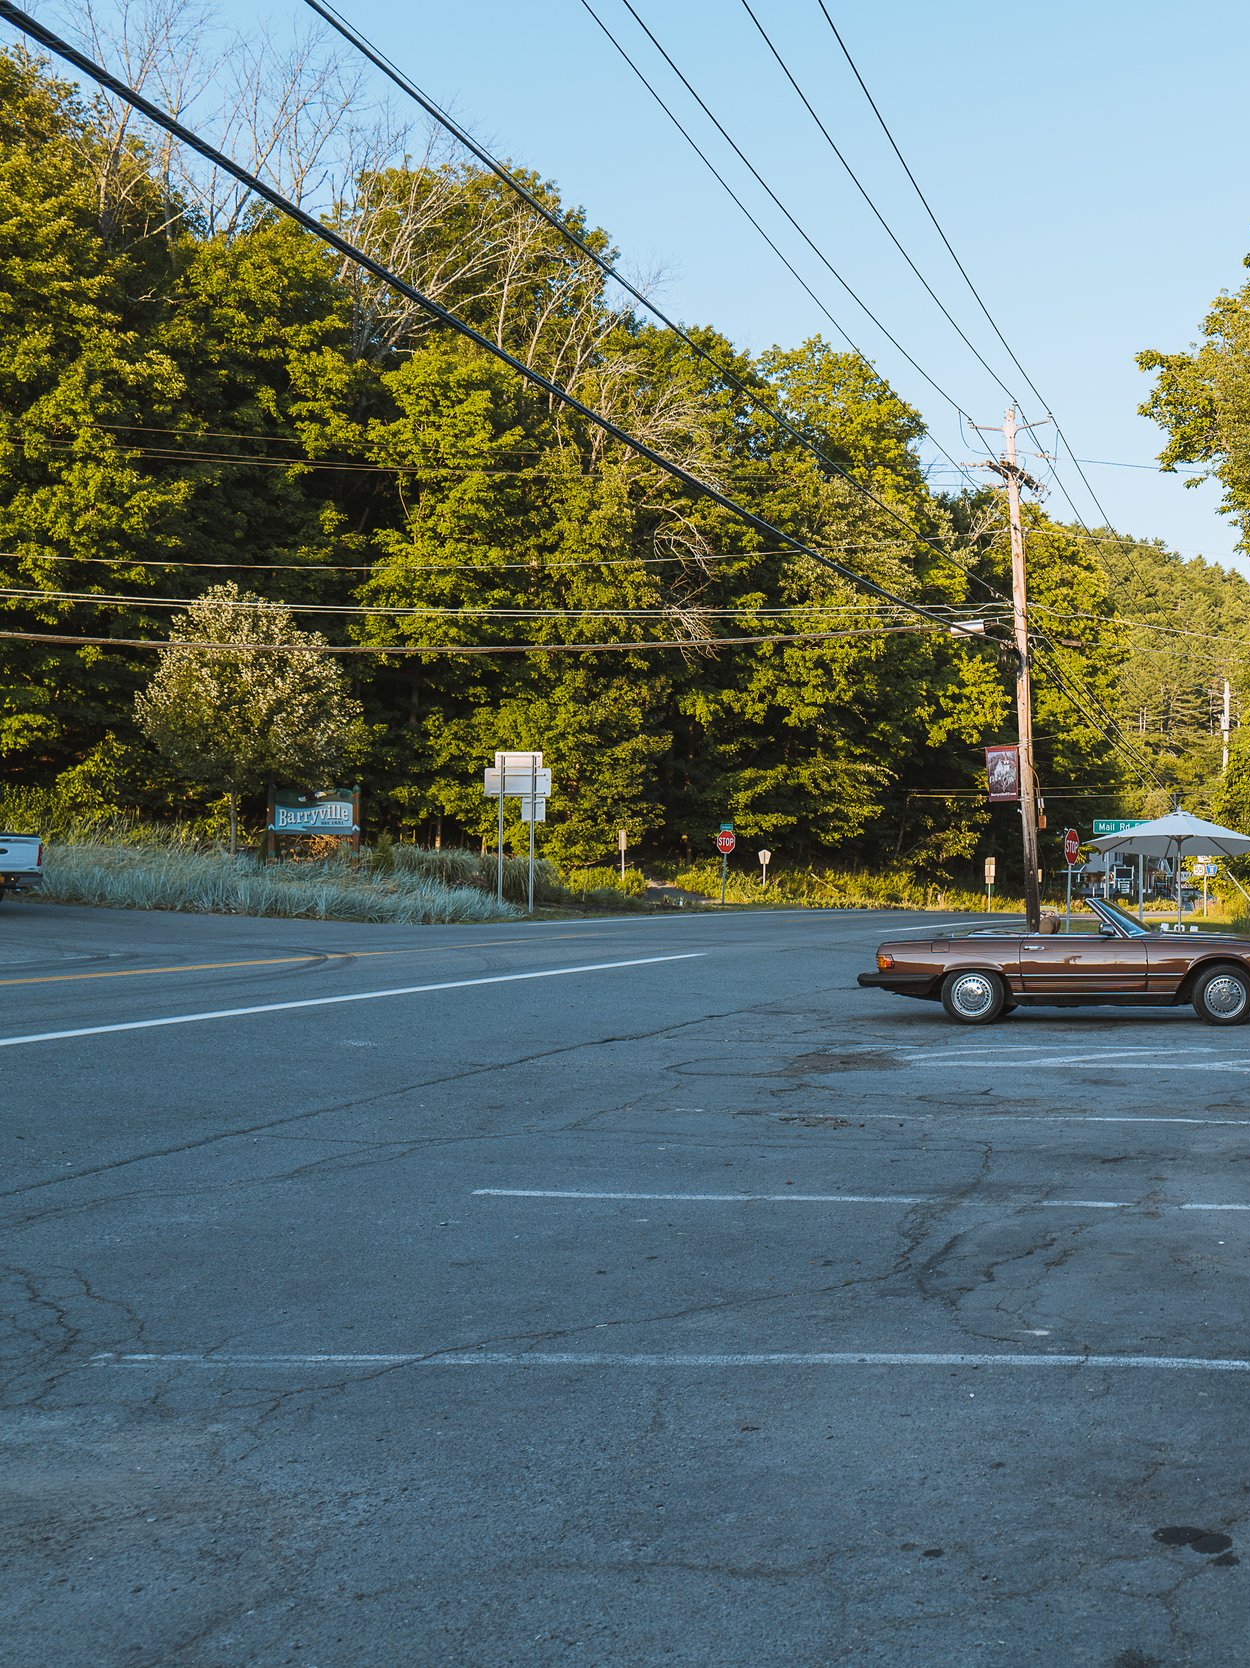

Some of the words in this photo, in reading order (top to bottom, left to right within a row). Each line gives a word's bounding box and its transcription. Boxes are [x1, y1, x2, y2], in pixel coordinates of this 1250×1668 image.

[279, 804, 349, 826] Barryville
[1098, 822, 1115, 831] Mail
[1119, 822, 1131, 831] Rd
[719, 837, 734, 846] STOP
[1066, 840, 1079, 854] STOP
[1194, 866, 1204, 874] 55
